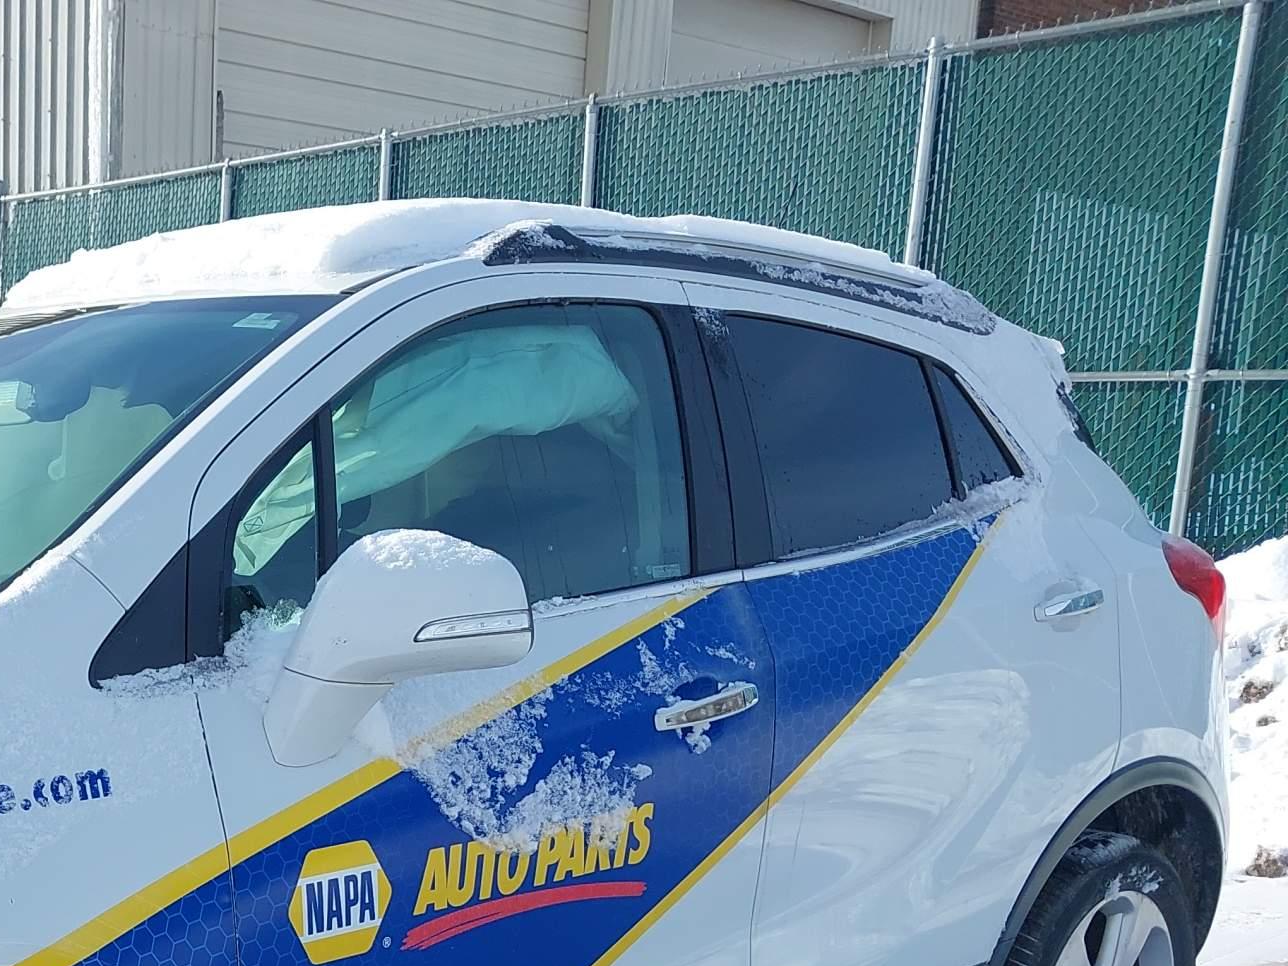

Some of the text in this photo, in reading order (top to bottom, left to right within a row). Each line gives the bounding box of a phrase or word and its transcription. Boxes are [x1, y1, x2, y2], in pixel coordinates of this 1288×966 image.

[305, 802, 655, 936] NAPA AUTO PARTS
